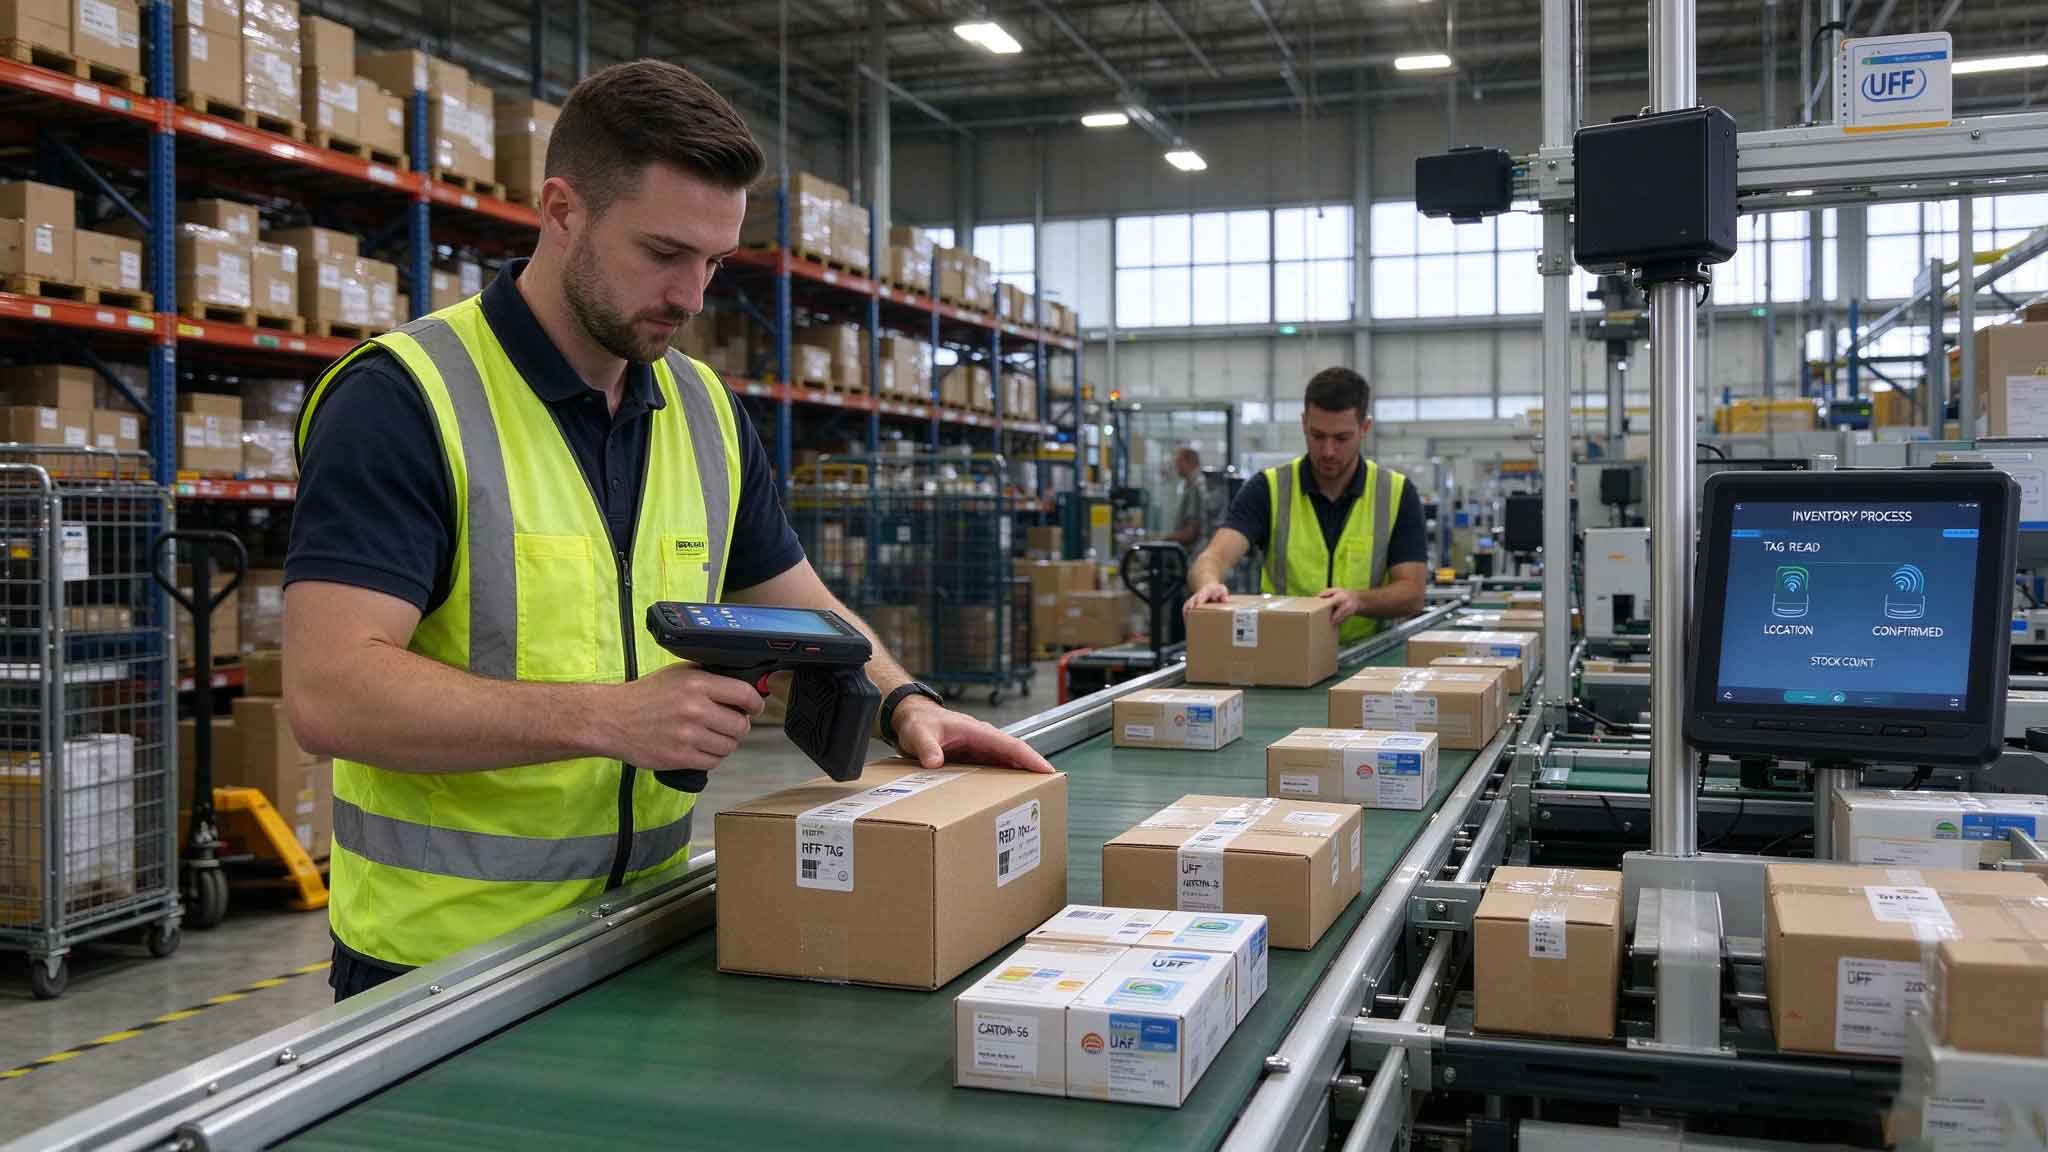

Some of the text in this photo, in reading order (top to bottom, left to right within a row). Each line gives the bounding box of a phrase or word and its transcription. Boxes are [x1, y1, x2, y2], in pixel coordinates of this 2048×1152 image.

[1870, 69, 1915, 96] UFF
[1792, 511, 1913, 522] INVENTORY PROCESS
[1763, 541, 1821, 553] TAG READ
[1763, 624, 1814, 636] LOCATION
[824, 845, 844, 857] TAG
